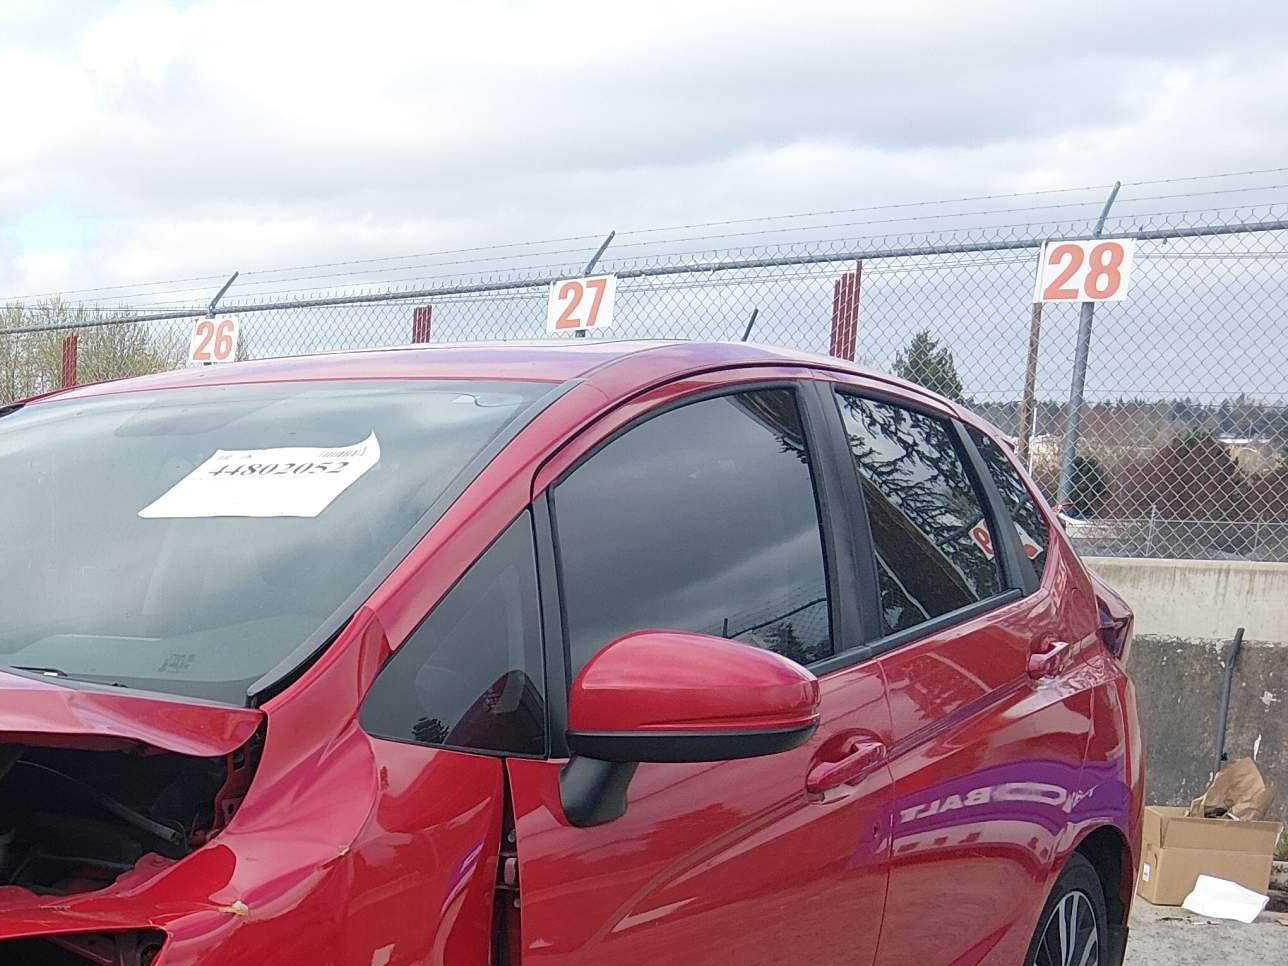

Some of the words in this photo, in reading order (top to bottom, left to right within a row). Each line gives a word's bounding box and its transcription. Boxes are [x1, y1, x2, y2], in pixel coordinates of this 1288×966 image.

[1043, 241, 1125, 300] 28
[555, 278, 607, 330] 27
[192, 319, 234, 360] 26
[208, 461, 349, 476] 44802052
